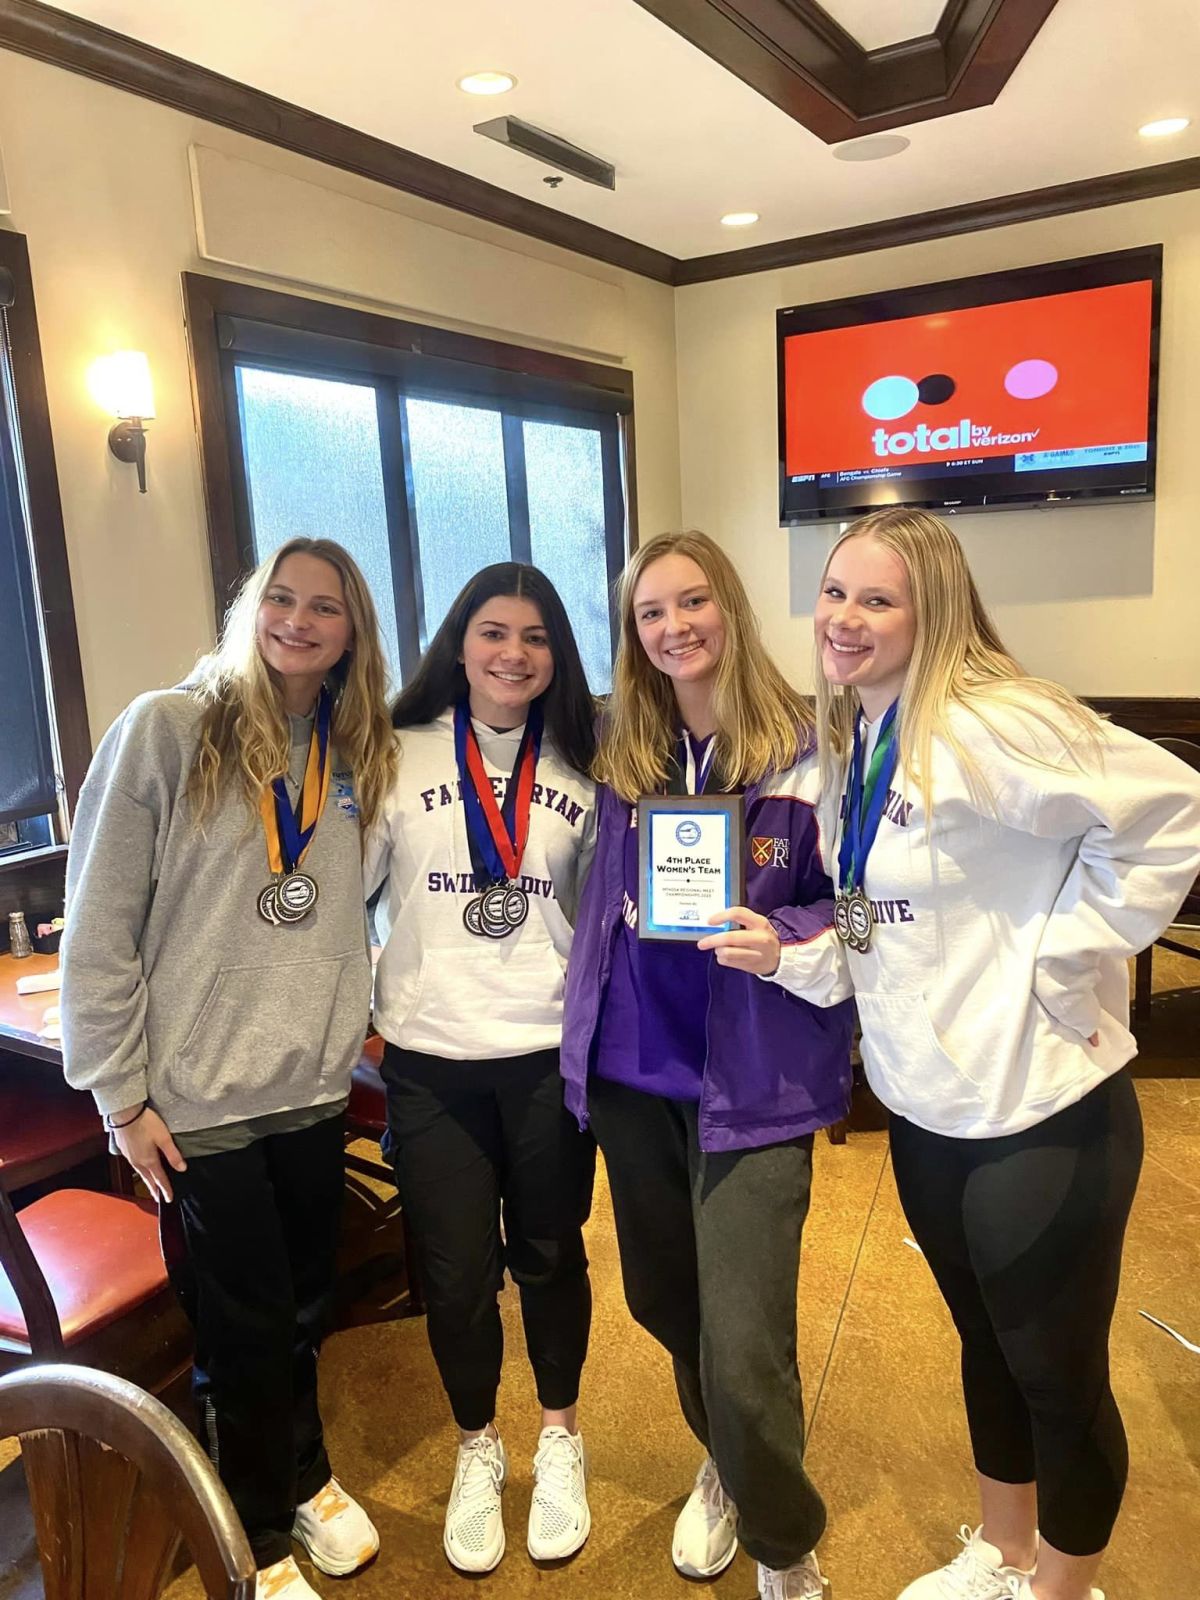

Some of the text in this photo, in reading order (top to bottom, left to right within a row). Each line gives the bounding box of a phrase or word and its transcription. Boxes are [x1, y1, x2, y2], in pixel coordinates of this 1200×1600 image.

[872, 419, 971, 456] total
[971, 424, 992, 437] by
[972, 432, 1032, 447] verizon
[791, 474, 815, 483] ESPN
[851, 473, 886, 481] Championship
[531, 782, 585, 827] RYAN
[685, 856, 711, 865] PLACE
[698, 866, 721, 875] TEAM
[521, 875, 557, 899] DIV
[869, 899, 915, 923] DIVE
